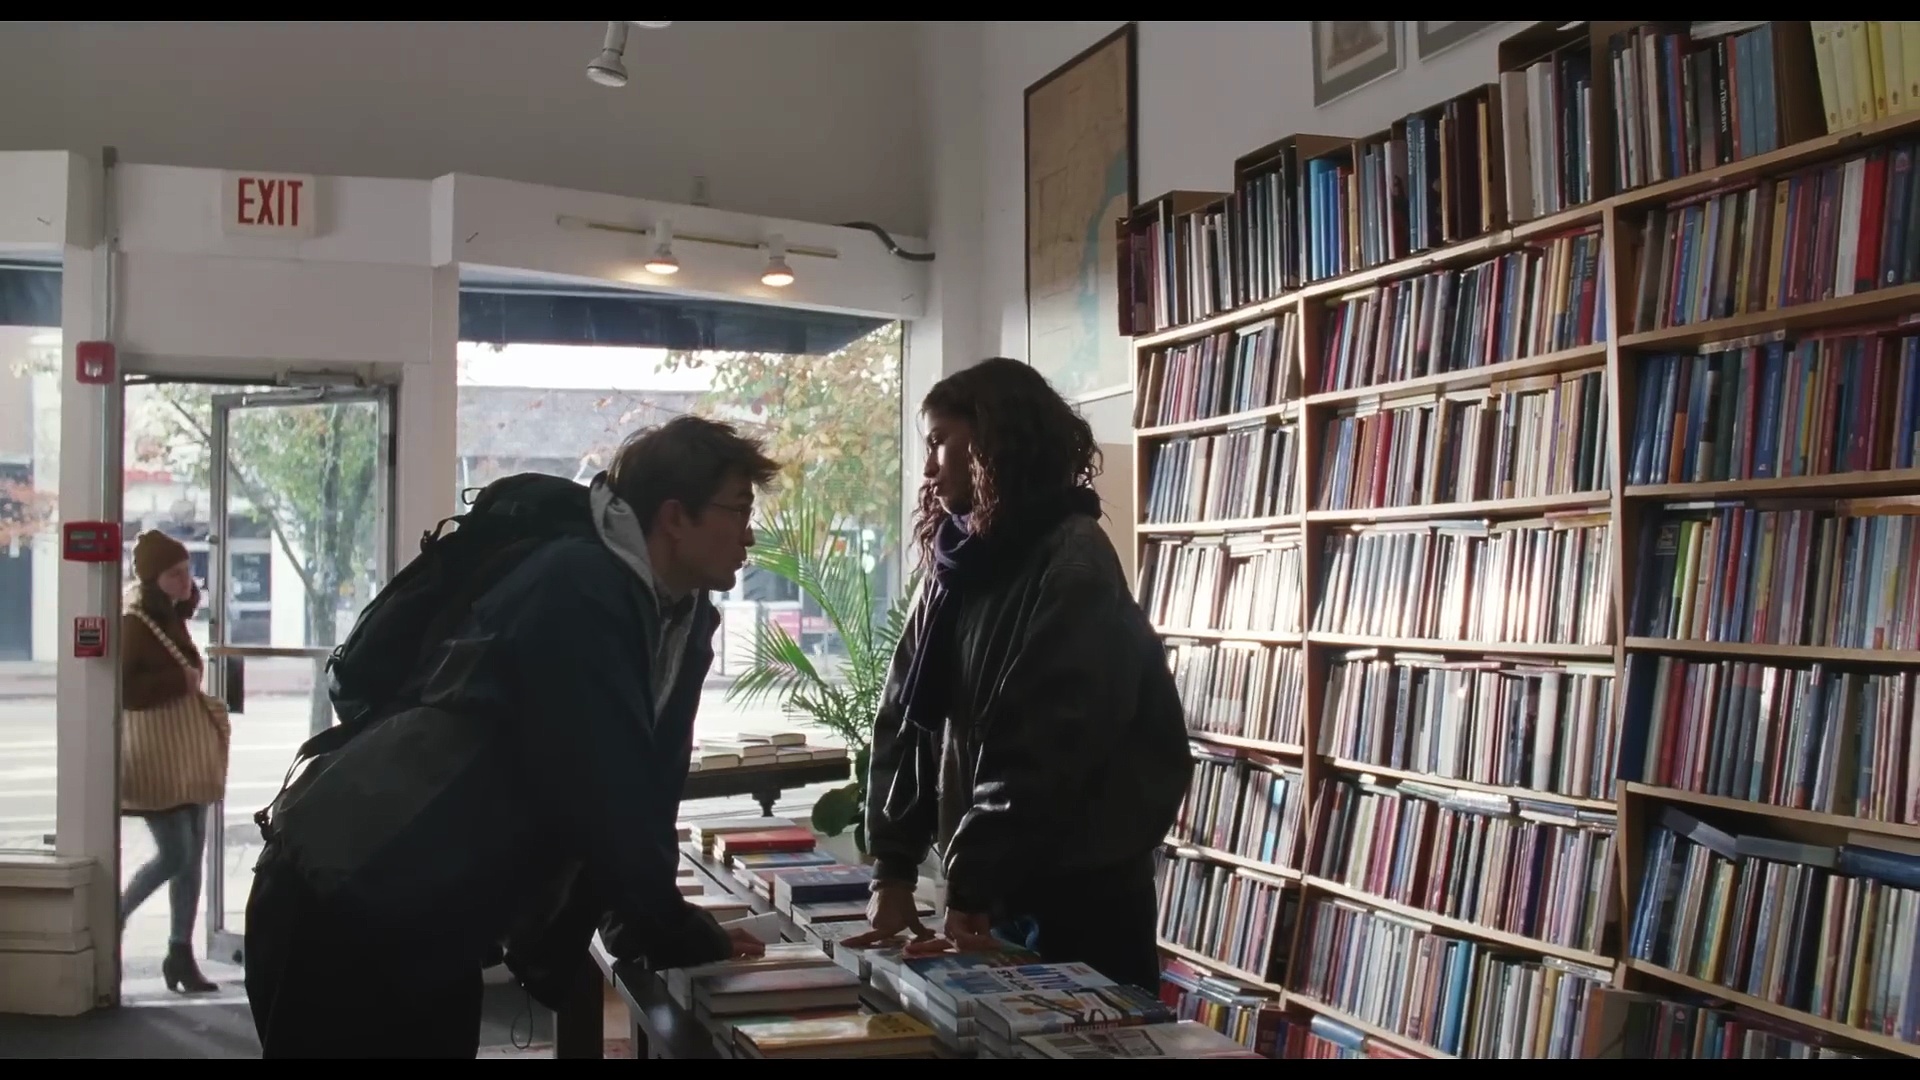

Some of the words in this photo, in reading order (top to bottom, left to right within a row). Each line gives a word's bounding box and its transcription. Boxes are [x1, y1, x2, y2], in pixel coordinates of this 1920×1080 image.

[1720, 90, 1728, 133] Tibetans
[238, 177, 303, 226] EXIT
[77, 618, 101, 629] FIRE
